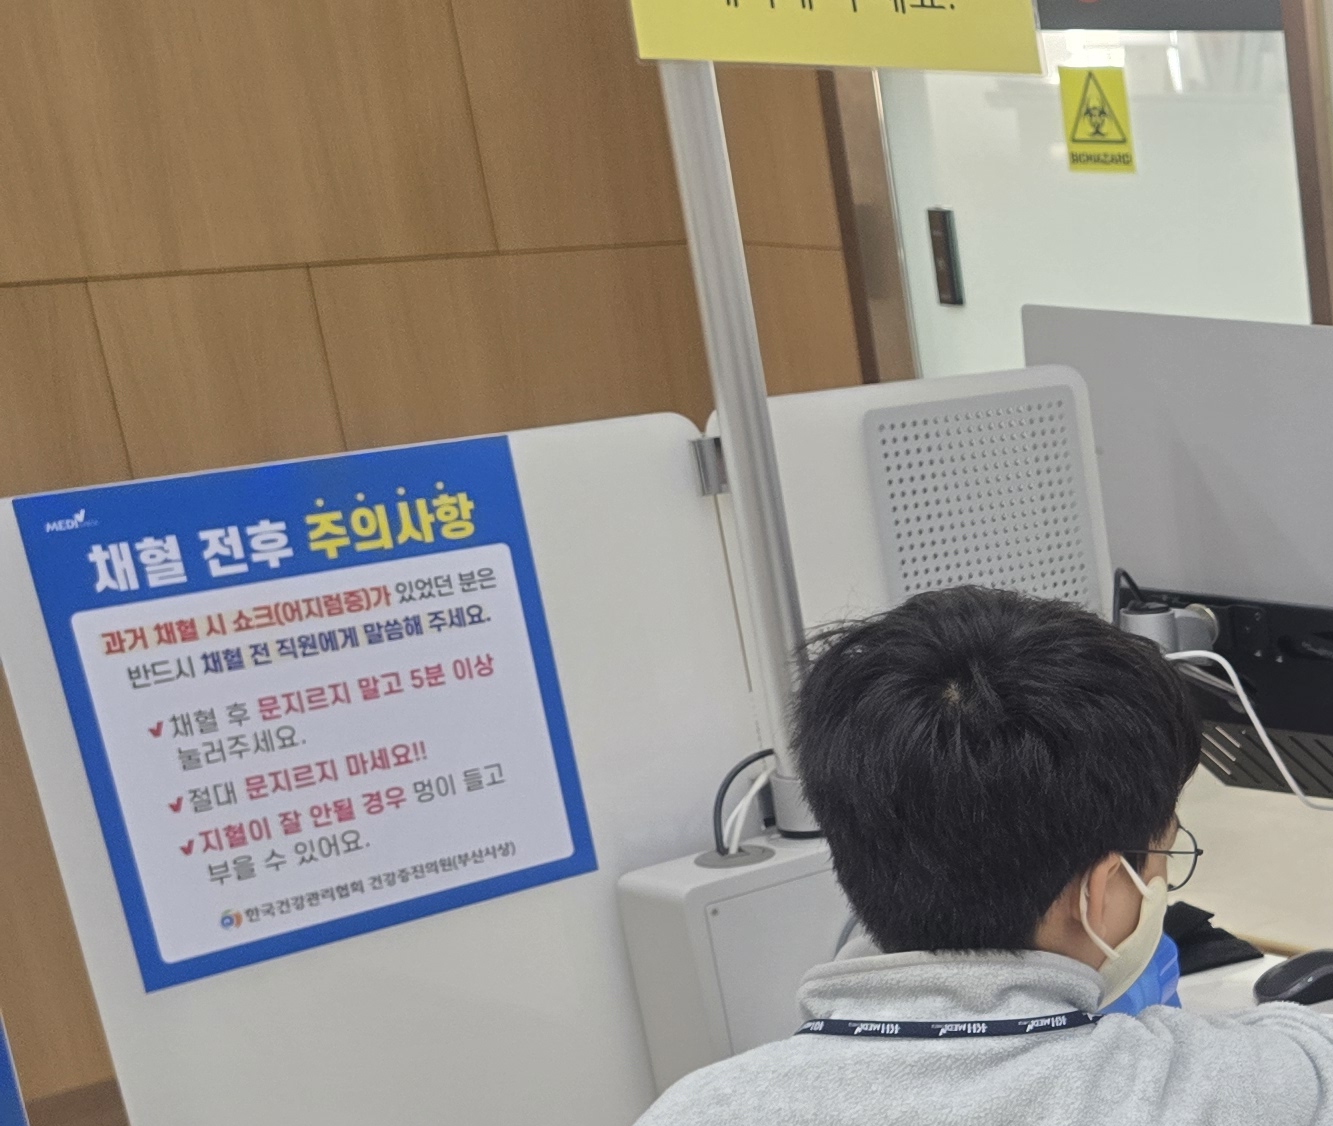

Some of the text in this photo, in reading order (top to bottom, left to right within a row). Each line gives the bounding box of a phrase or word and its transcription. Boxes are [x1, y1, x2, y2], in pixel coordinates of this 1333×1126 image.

[88, 492, 475, 593] 채혈 전후 주의사항
[101, 567, 497, 655] 과거 채혈 시 쇼크(어지럼증)가 있었던 분은
[127, 604, 491, 690] 반드시 채혈 전 직원에게 말씀해 주세요.
[169, 653, 494, 738] 채혈 후 문지르지 말고 5분 이상
[177, 725, 306, 772] 눌러주세요.
[188, 740, 428, 814] 절대 문지르지 마세요!!
[199, 763, 506, 853] 지혈이 잘 안될 경우 멍이 들고
[208, 829, 370, 885] 부을 수 있어요.
[245, 878, 365, 923] 한국건강관리협회
